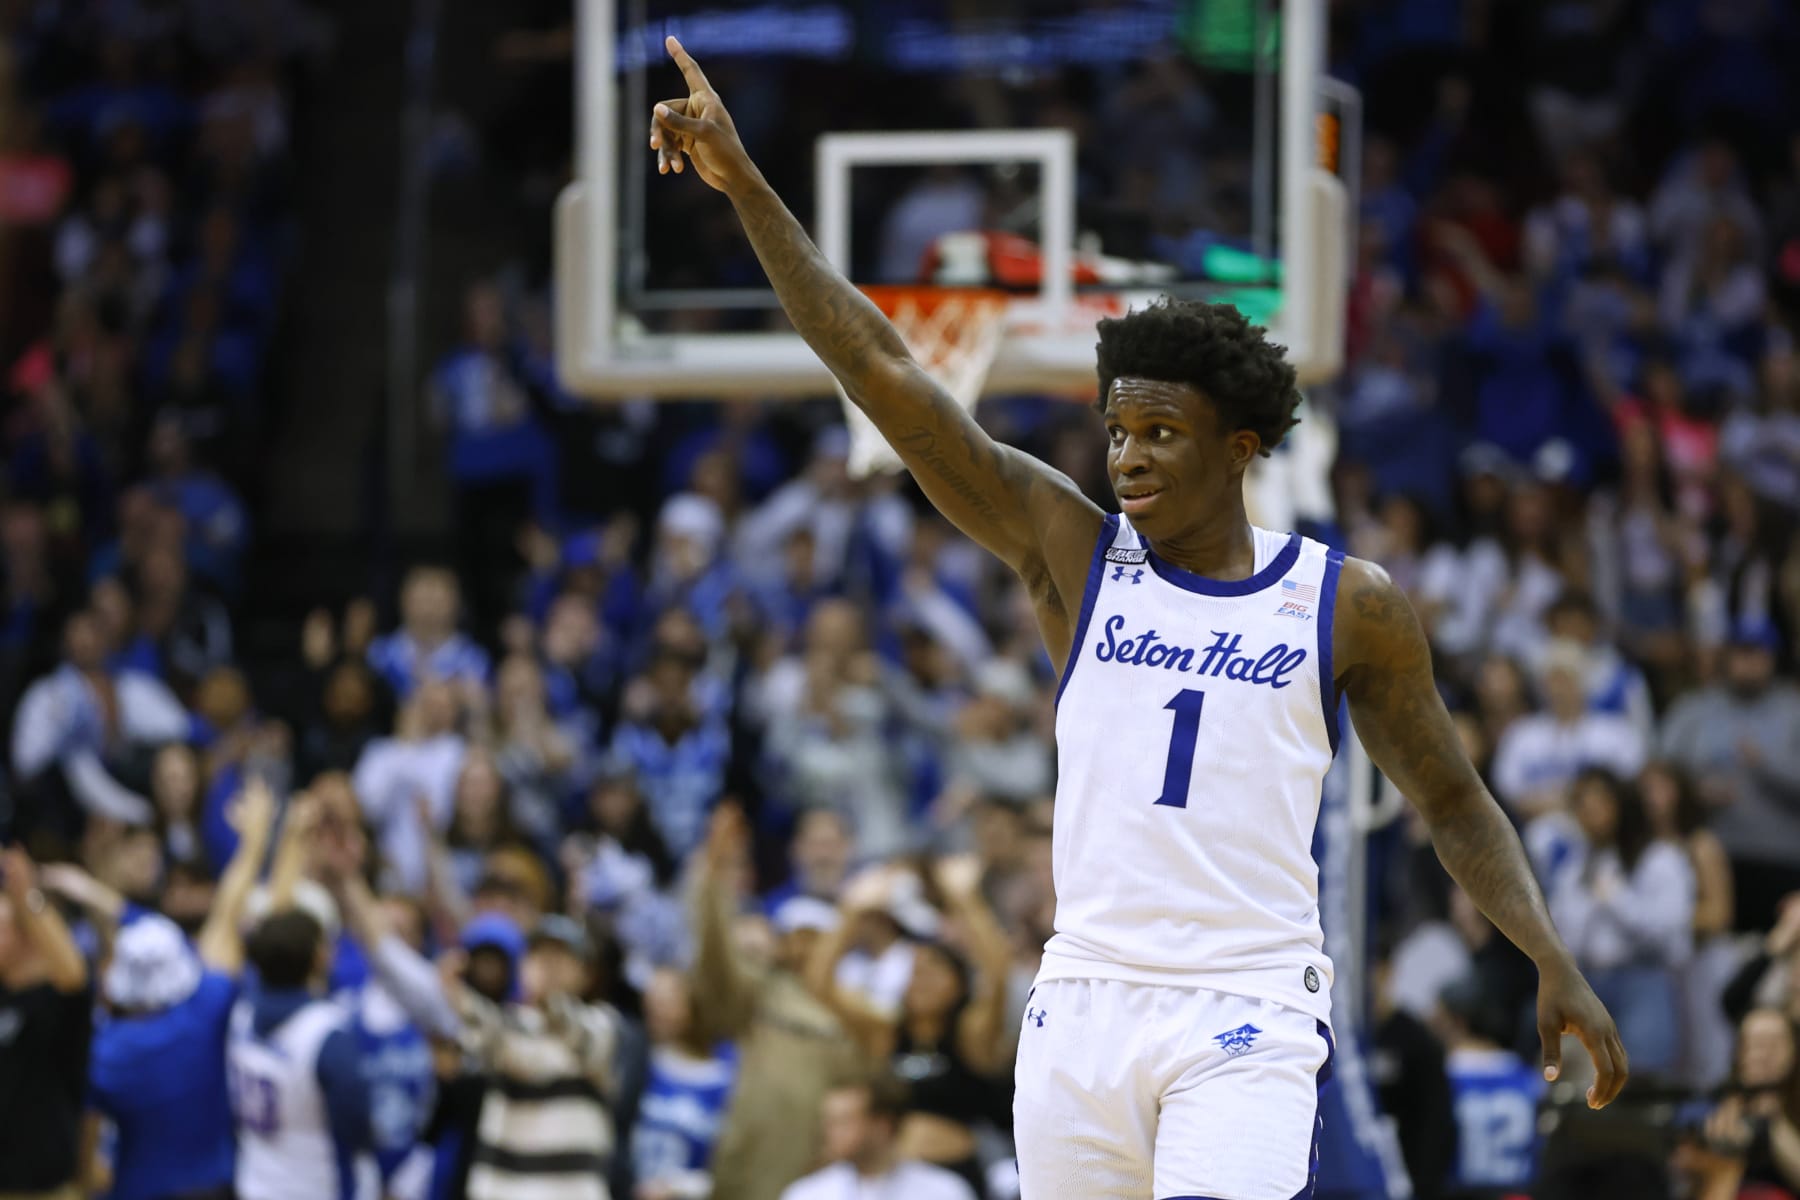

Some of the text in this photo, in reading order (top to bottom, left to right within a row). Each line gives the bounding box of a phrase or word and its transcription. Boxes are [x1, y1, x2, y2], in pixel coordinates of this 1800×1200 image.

[1278, 607, 1313, 620] EAST
[1283, 602, 1309, 612] BIG
[1096, 615, 1307, 689] Seton Hall
[1152, 688, 1205, 809] 1
